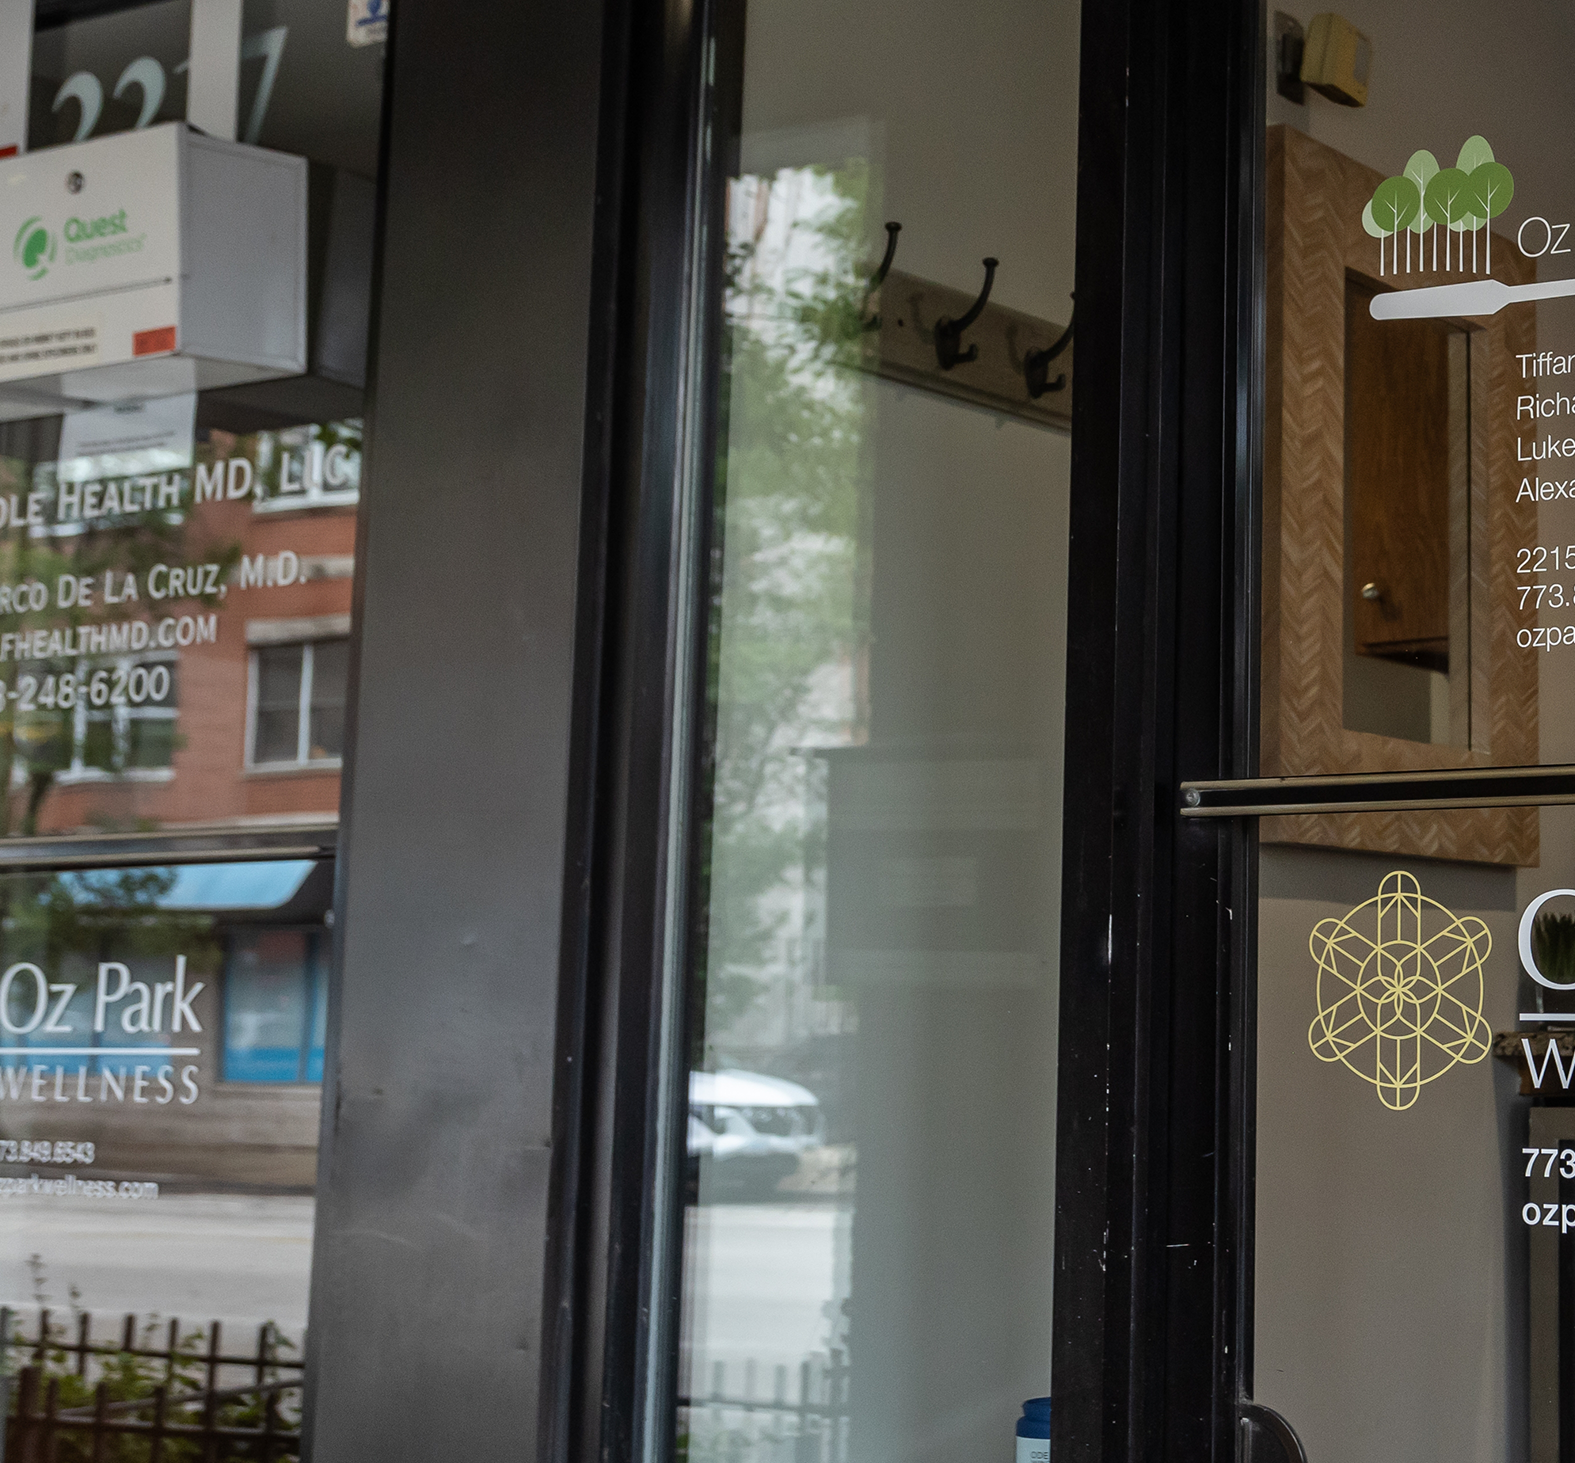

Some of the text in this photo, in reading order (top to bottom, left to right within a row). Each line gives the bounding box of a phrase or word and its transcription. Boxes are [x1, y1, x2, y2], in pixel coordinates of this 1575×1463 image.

[52, 25, 288, 144] 227
[63, 207, 128, 243] Quest
[1517, 216, 1570, 258] Oz
[58, 474, 181, 521] HEALTH
[280, 443, 348, 493] LLC
[57, 573, 95, 609] DE
[104, 571, 139, 605] LA
[148, 563, 228, 600] CRUZ,
[240, 550, 307, 590] M.D.
[0, 954, 206, 1035] Oz Park
[0, 1064, 199, 1105] WELLNESS
